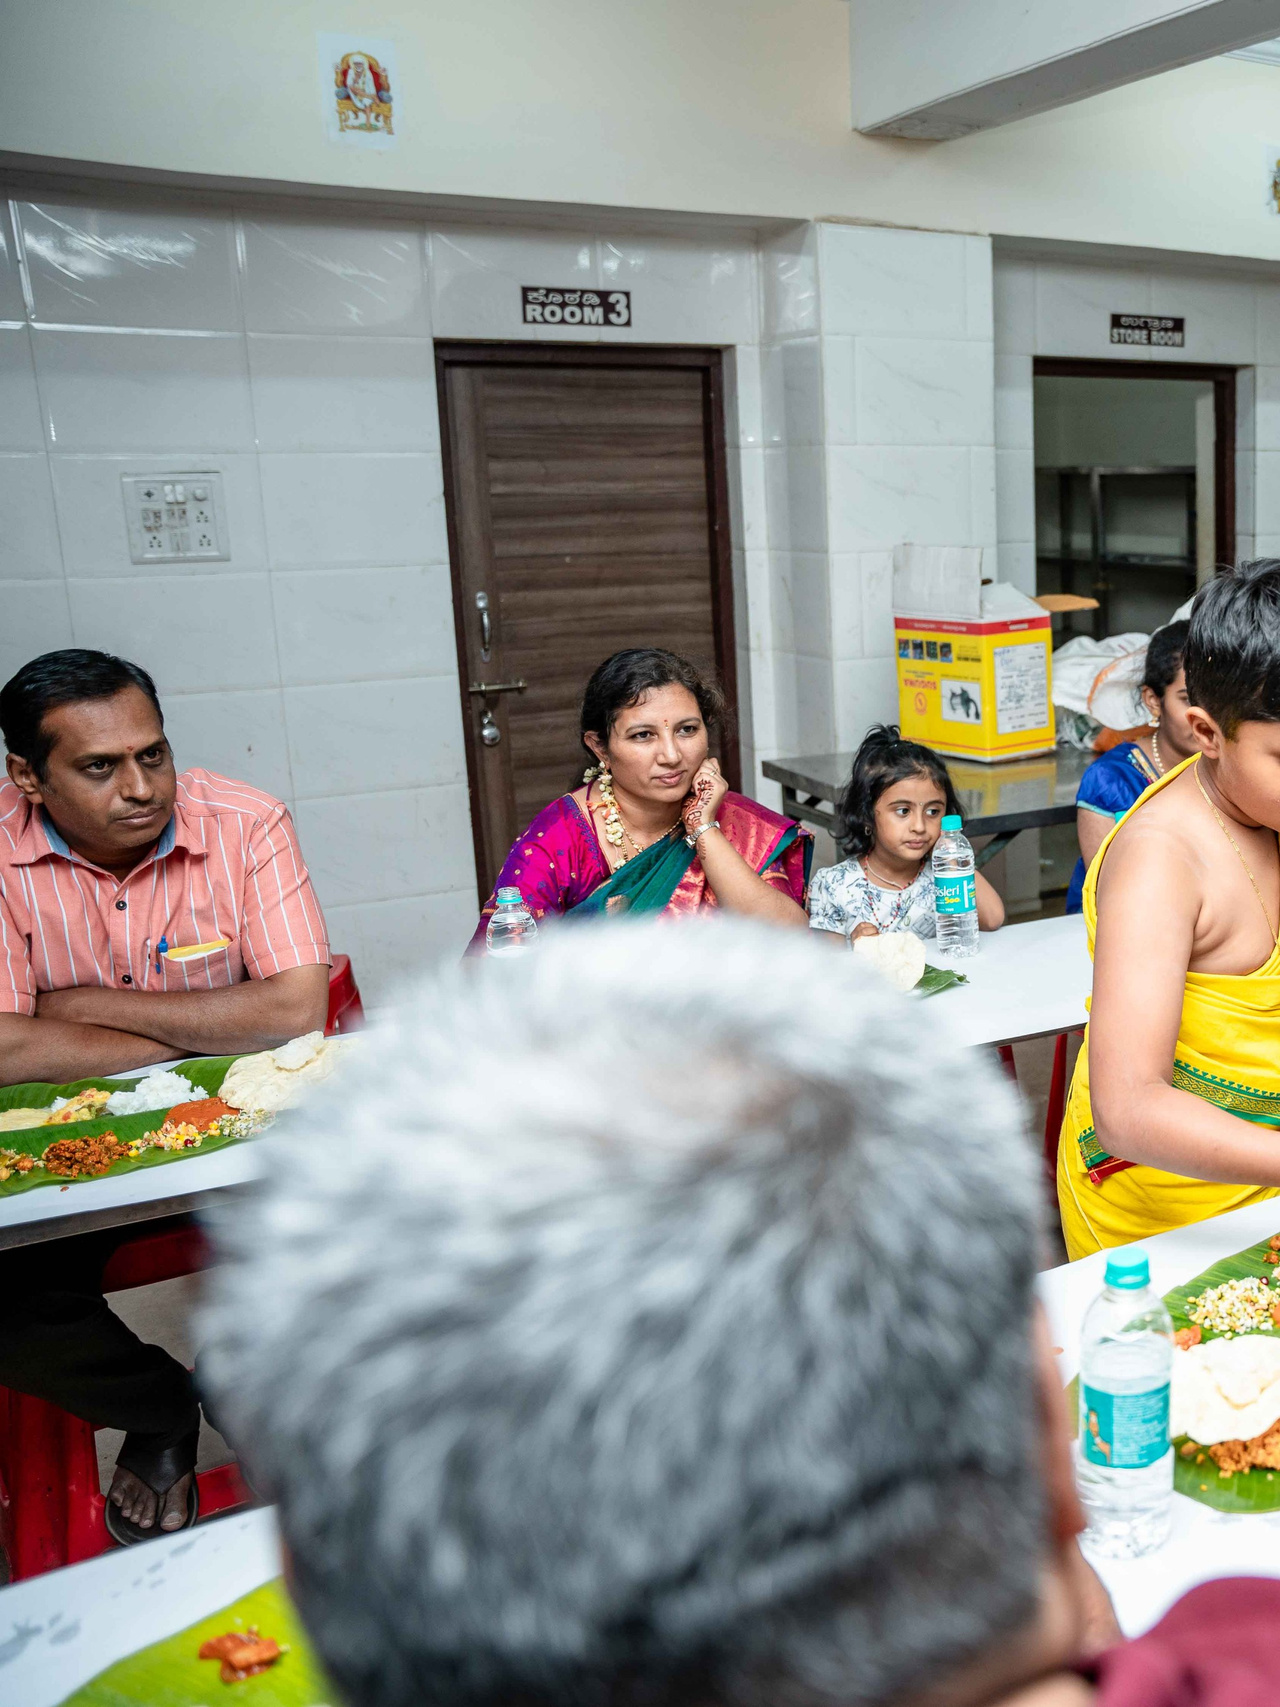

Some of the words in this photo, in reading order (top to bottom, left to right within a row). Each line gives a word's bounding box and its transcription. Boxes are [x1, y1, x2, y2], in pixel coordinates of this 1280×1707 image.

[525, 304, 604, 324] ROOM
[608, 293, 630, 325] 3
[1111, 328, 1148, 344] STORE
[1150, 330, 1183, 347] ROOM
